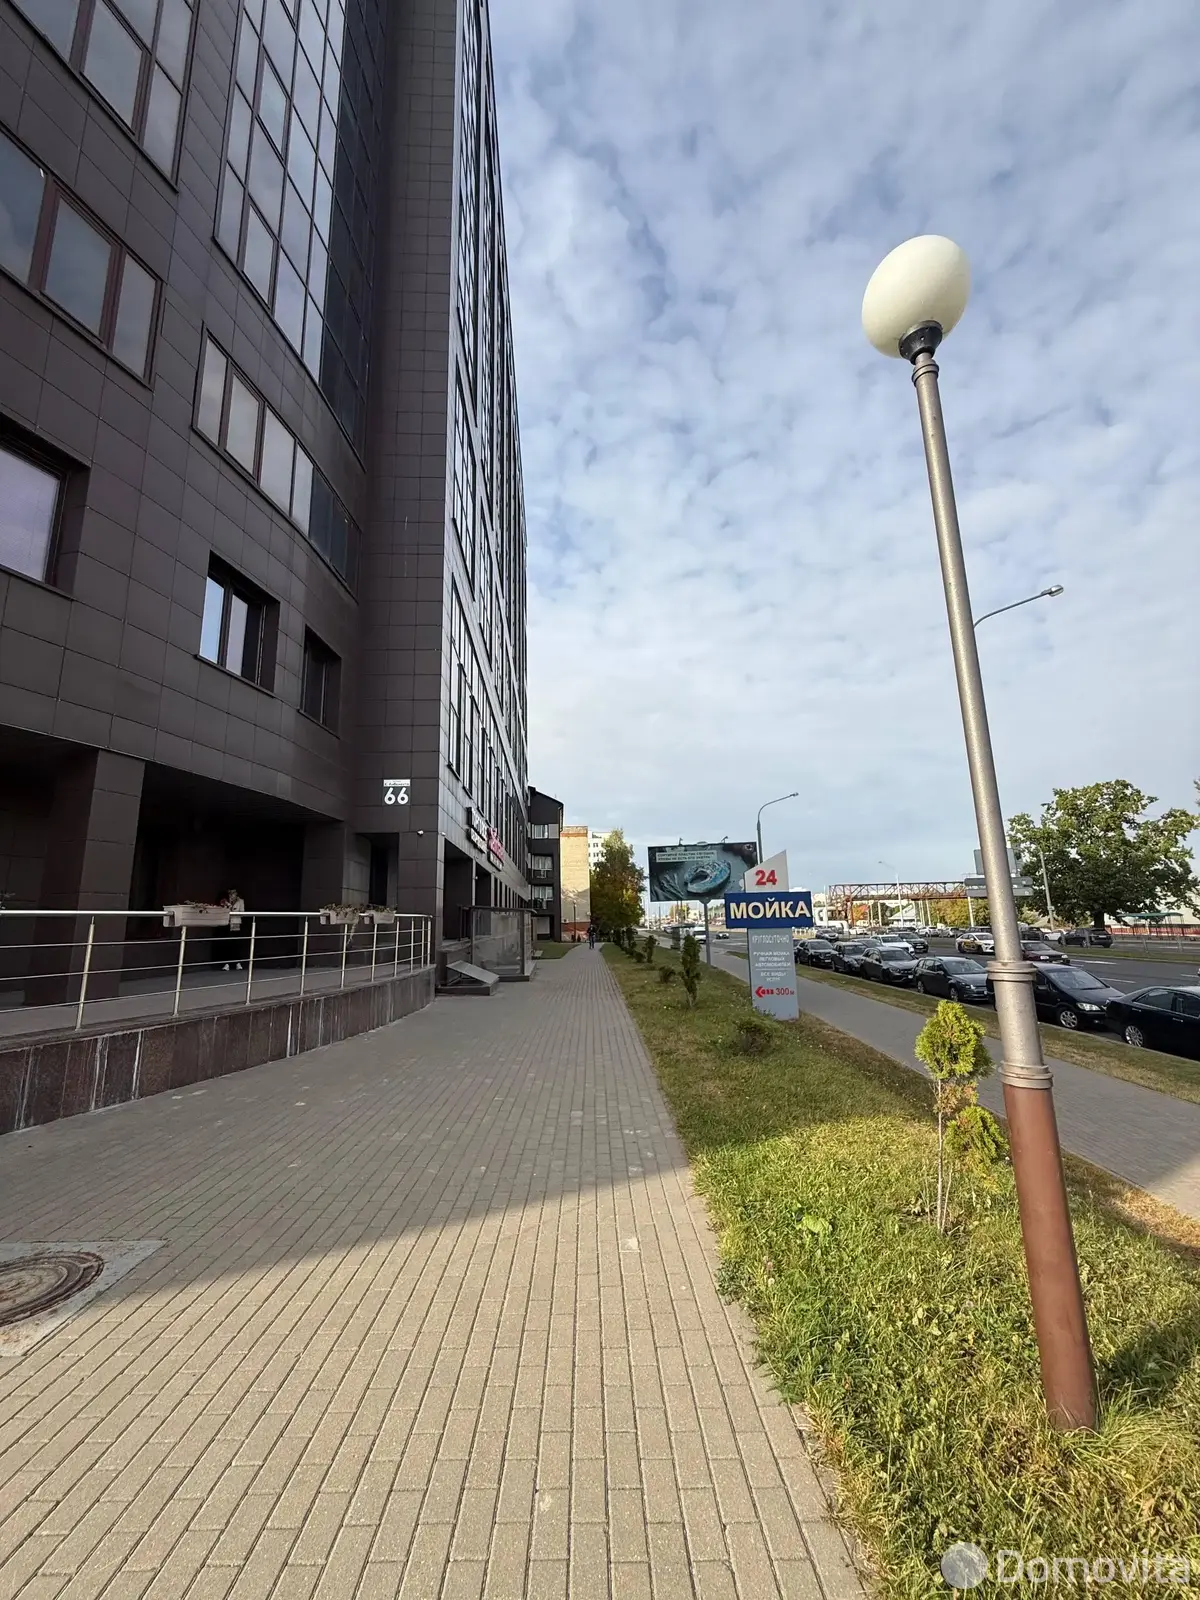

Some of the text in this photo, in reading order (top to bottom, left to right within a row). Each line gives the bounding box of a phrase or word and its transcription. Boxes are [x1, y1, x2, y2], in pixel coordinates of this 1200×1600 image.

[384, 787, 409, 805] 66
[755, 869, 778, 886] 24
[729, 897, 812, 919] МОЙКА
[752, 934, 790, 944] КРУГЛОСУТОЧНО
